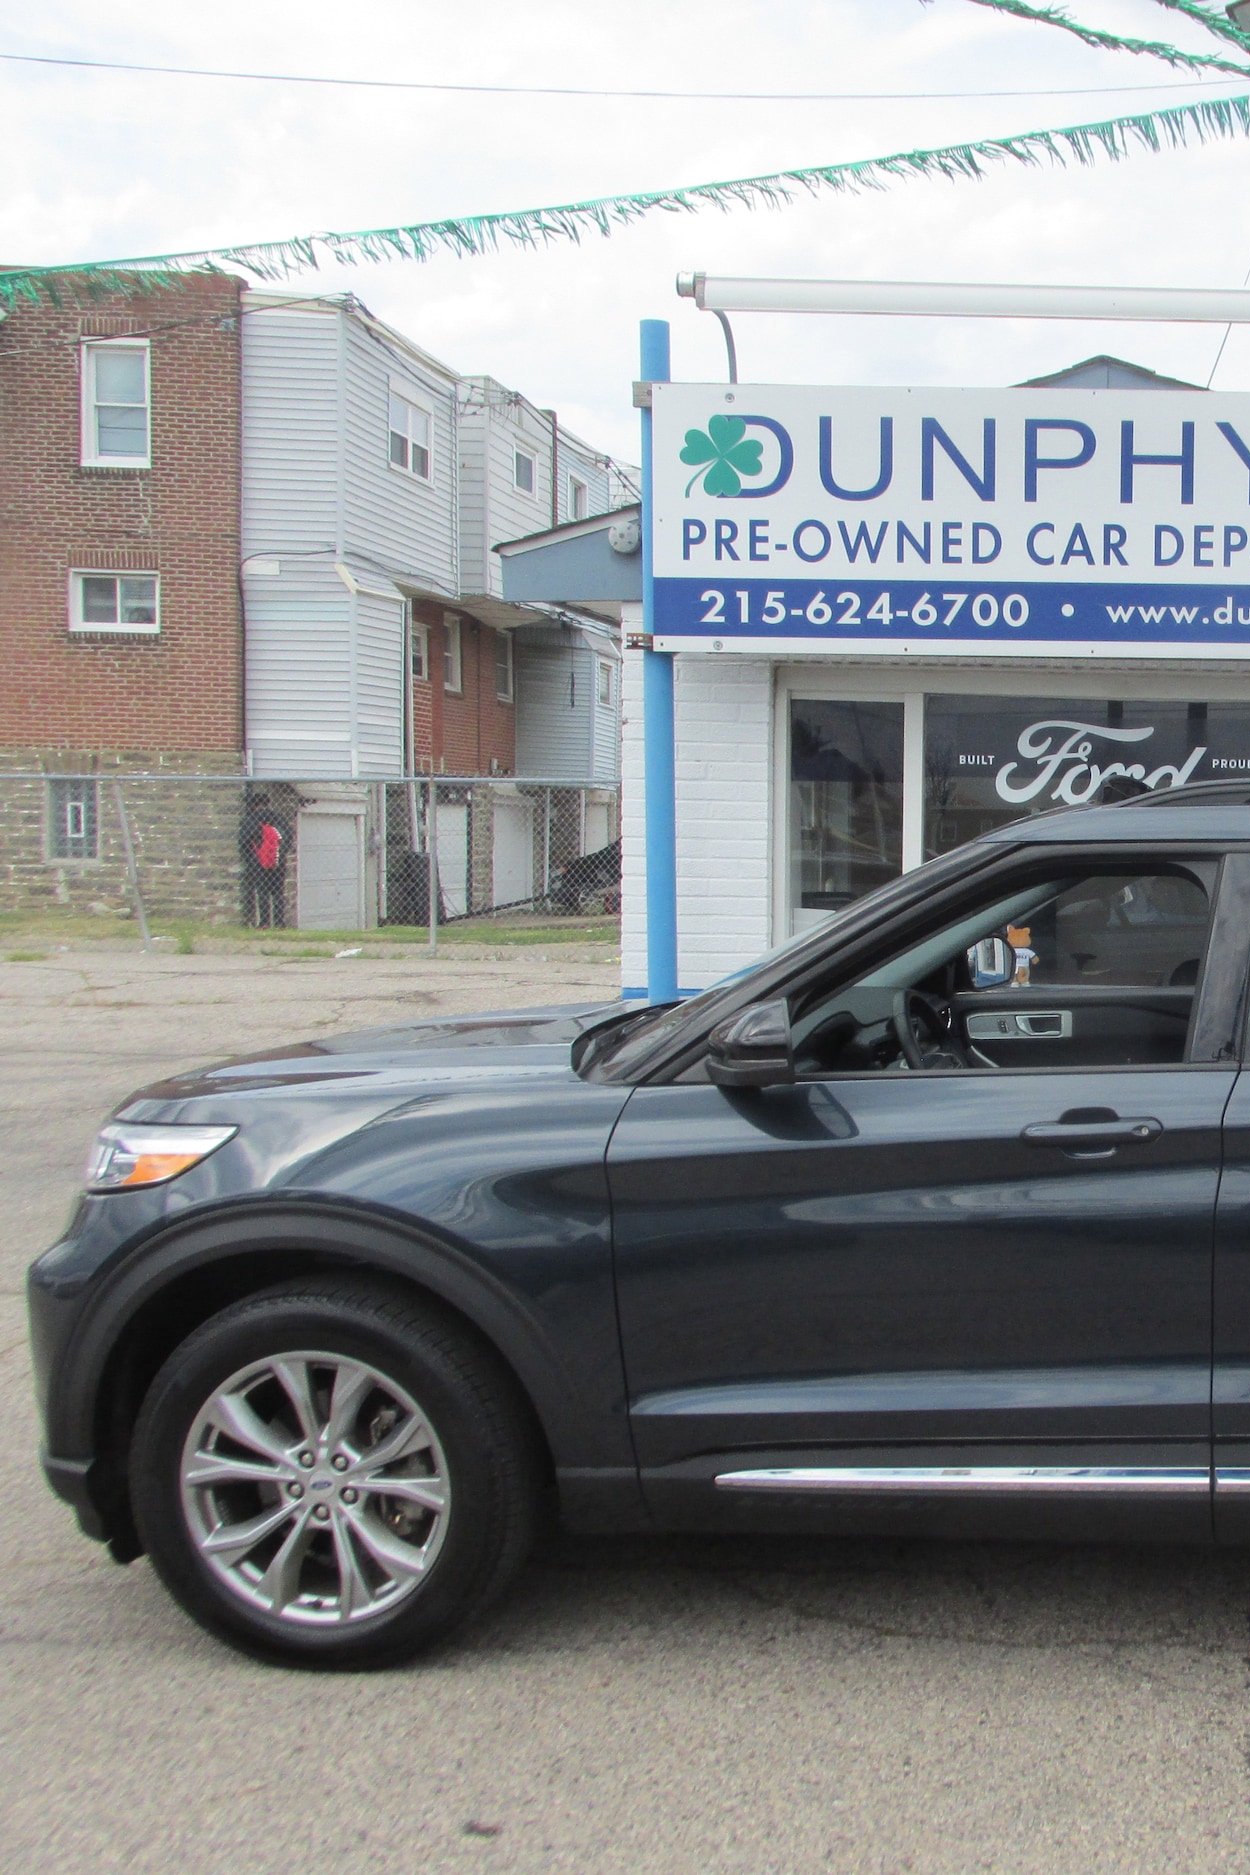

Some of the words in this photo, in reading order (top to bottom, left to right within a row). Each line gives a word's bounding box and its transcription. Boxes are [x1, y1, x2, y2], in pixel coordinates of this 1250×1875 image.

[682, 517, 1002, 565] PRE-OWNED
[1025, 521, 1129, 566] CAR
[700, 589, 1030, 629] 215-624-6700
[959, 754, 995, 766] BUILT
